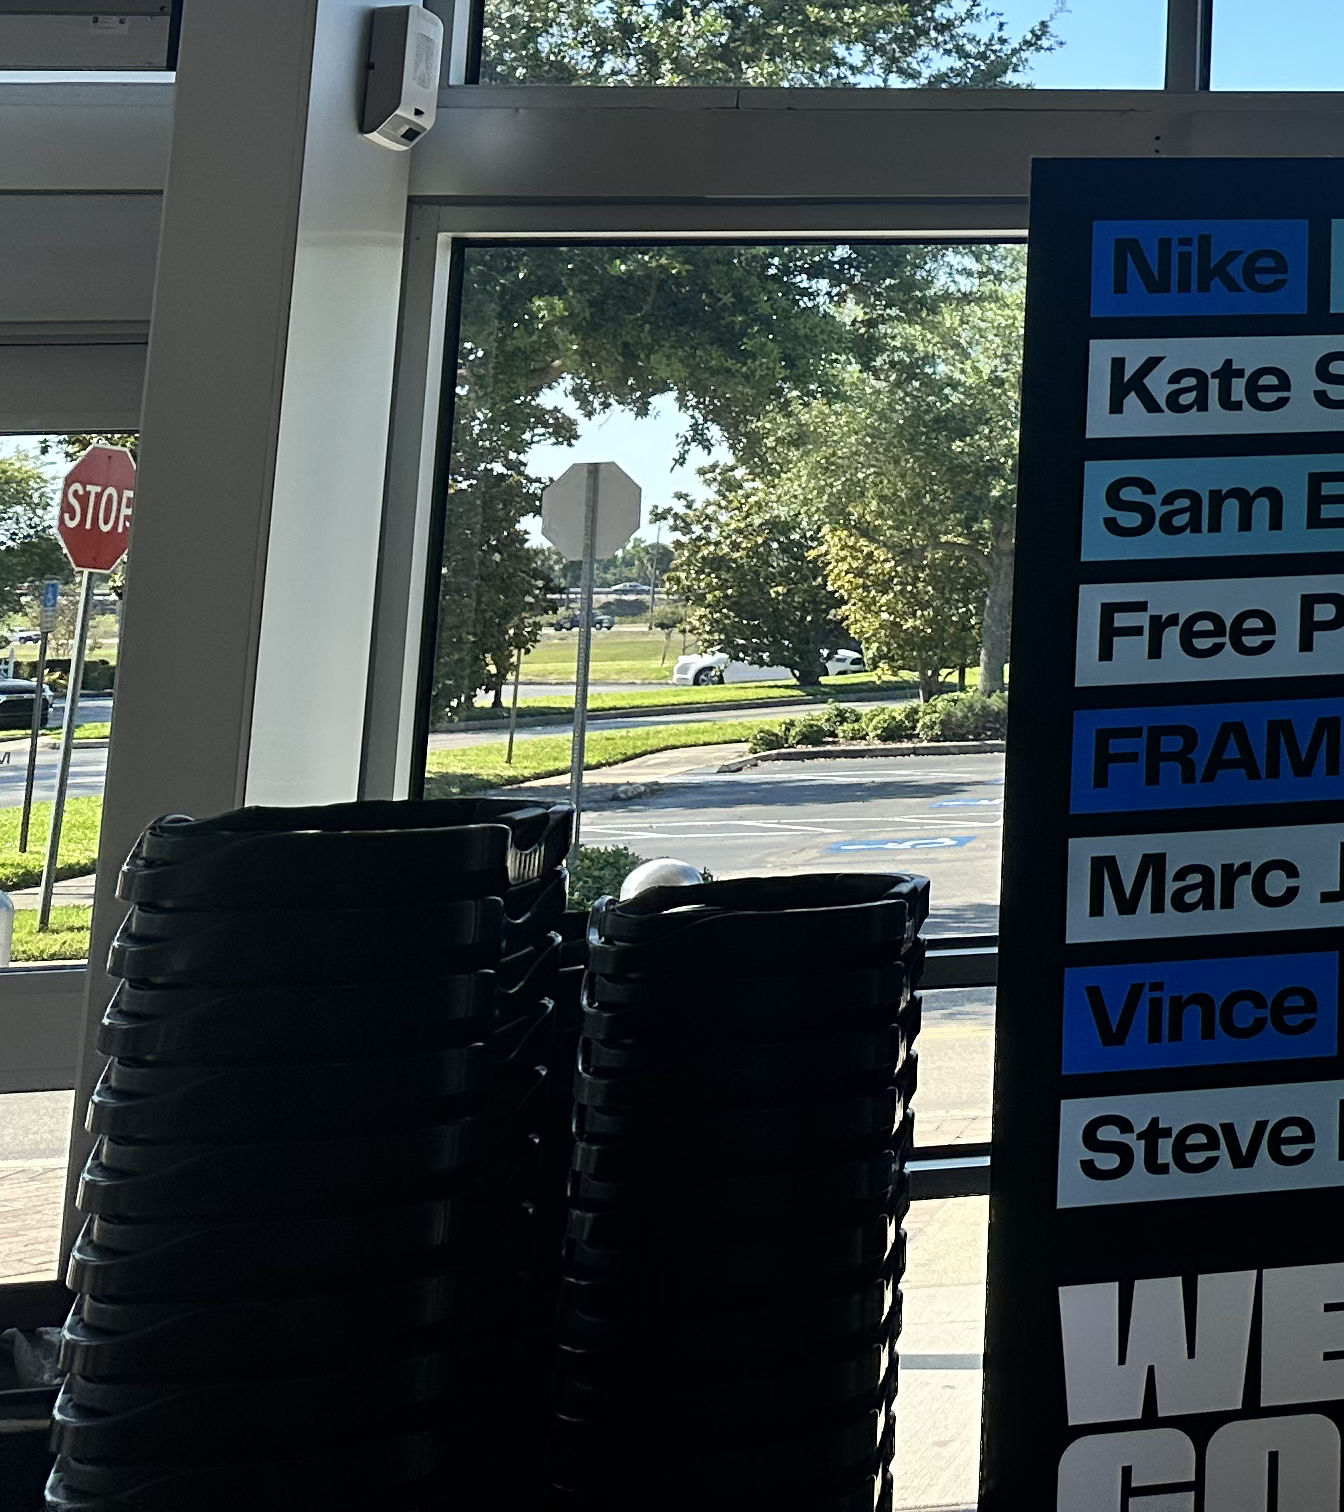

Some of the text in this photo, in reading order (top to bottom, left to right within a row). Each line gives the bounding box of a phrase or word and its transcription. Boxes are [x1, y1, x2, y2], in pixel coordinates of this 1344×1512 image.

[1113, 234, 1288, 294] Nike
[1109, 356, 1291, 414] Kate
[1103, 477, 1283, 537] Sam
[1099, 601, 1276, 662] Free
[1089, 852, 1300, 917] Marc
[1085, 981, 1318, 1047] Vince
[1080, 1115, 1315, 1180] Steve
